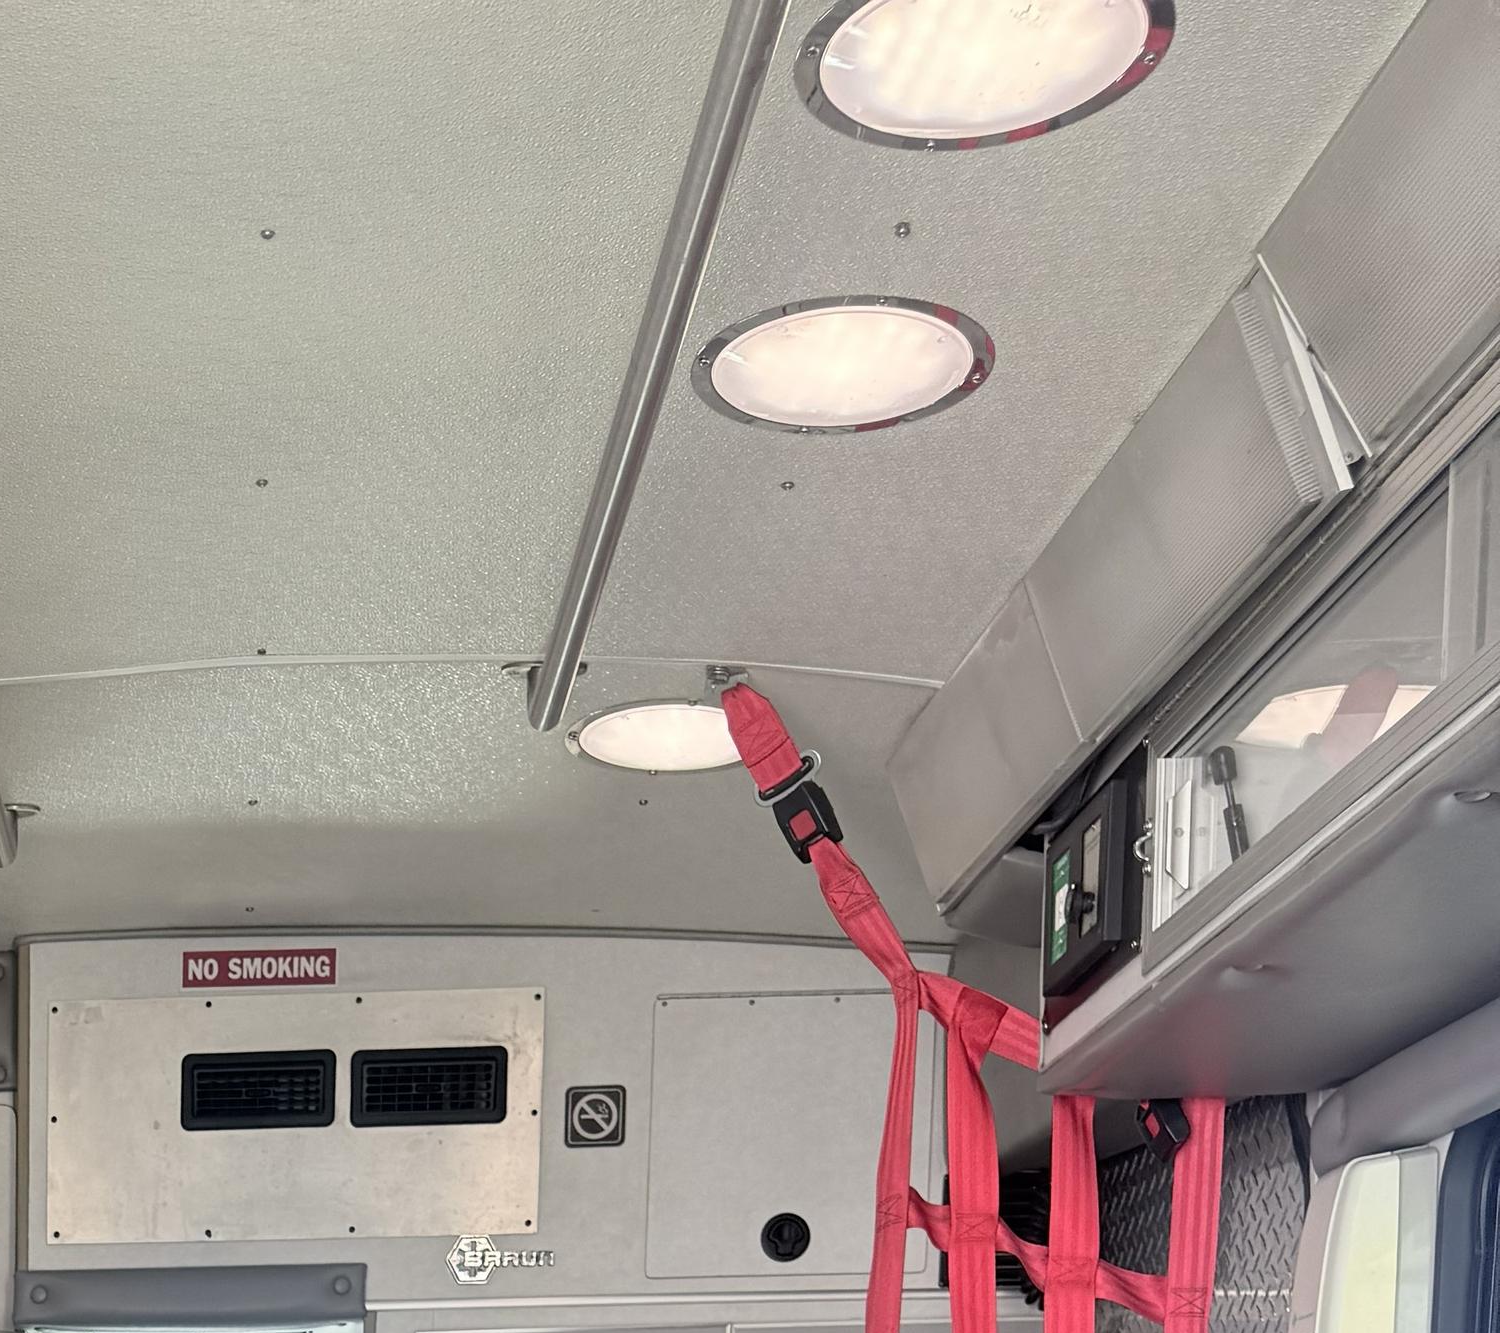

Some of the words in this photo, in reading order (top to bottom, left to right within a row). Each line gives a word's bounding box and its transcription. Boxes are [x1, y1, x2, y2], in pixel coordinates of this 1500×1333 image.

[188, 958, 219, 981] NO
[228, 955, 331, 980] SMOKING
[464, 1250, 555, 1267] BRAUN
